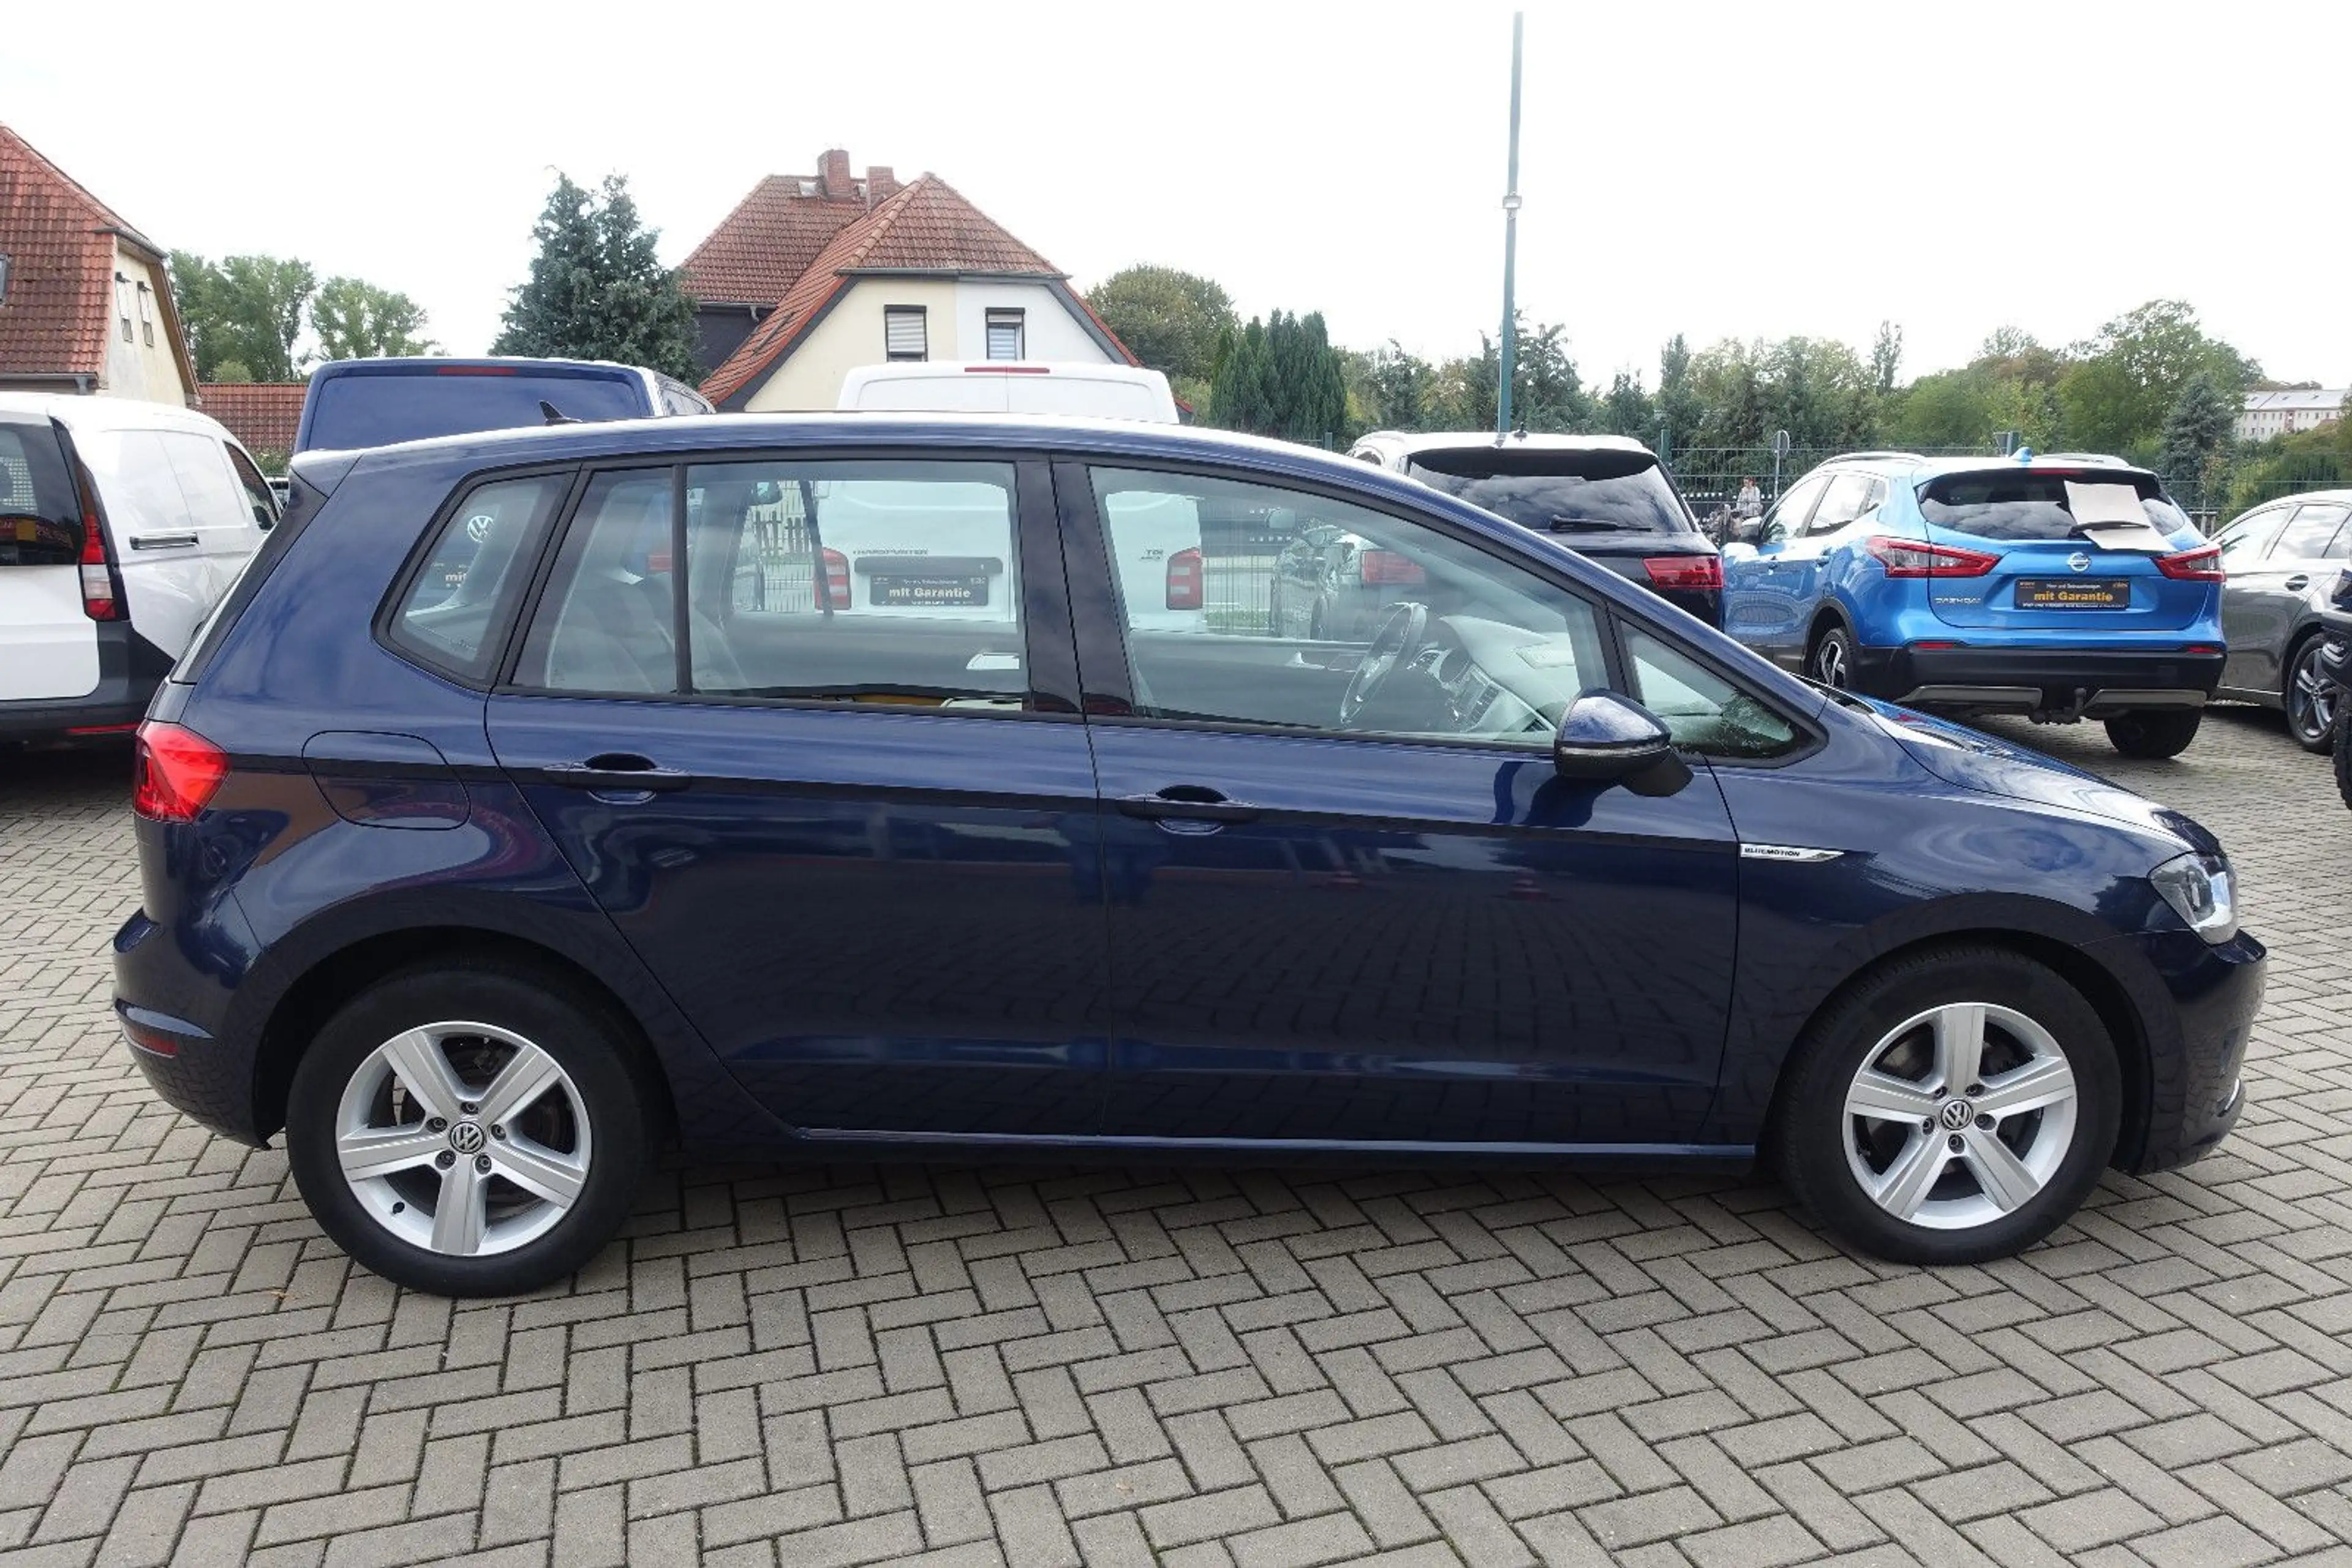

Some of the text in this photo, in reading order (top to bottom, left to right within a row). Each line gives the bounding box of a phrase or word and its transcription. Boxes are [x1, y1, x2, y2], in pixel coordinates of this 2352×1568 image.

[889, 587, 971, 597] mit Garantie
[2034, 590, 2113, 601] mit Garantie
